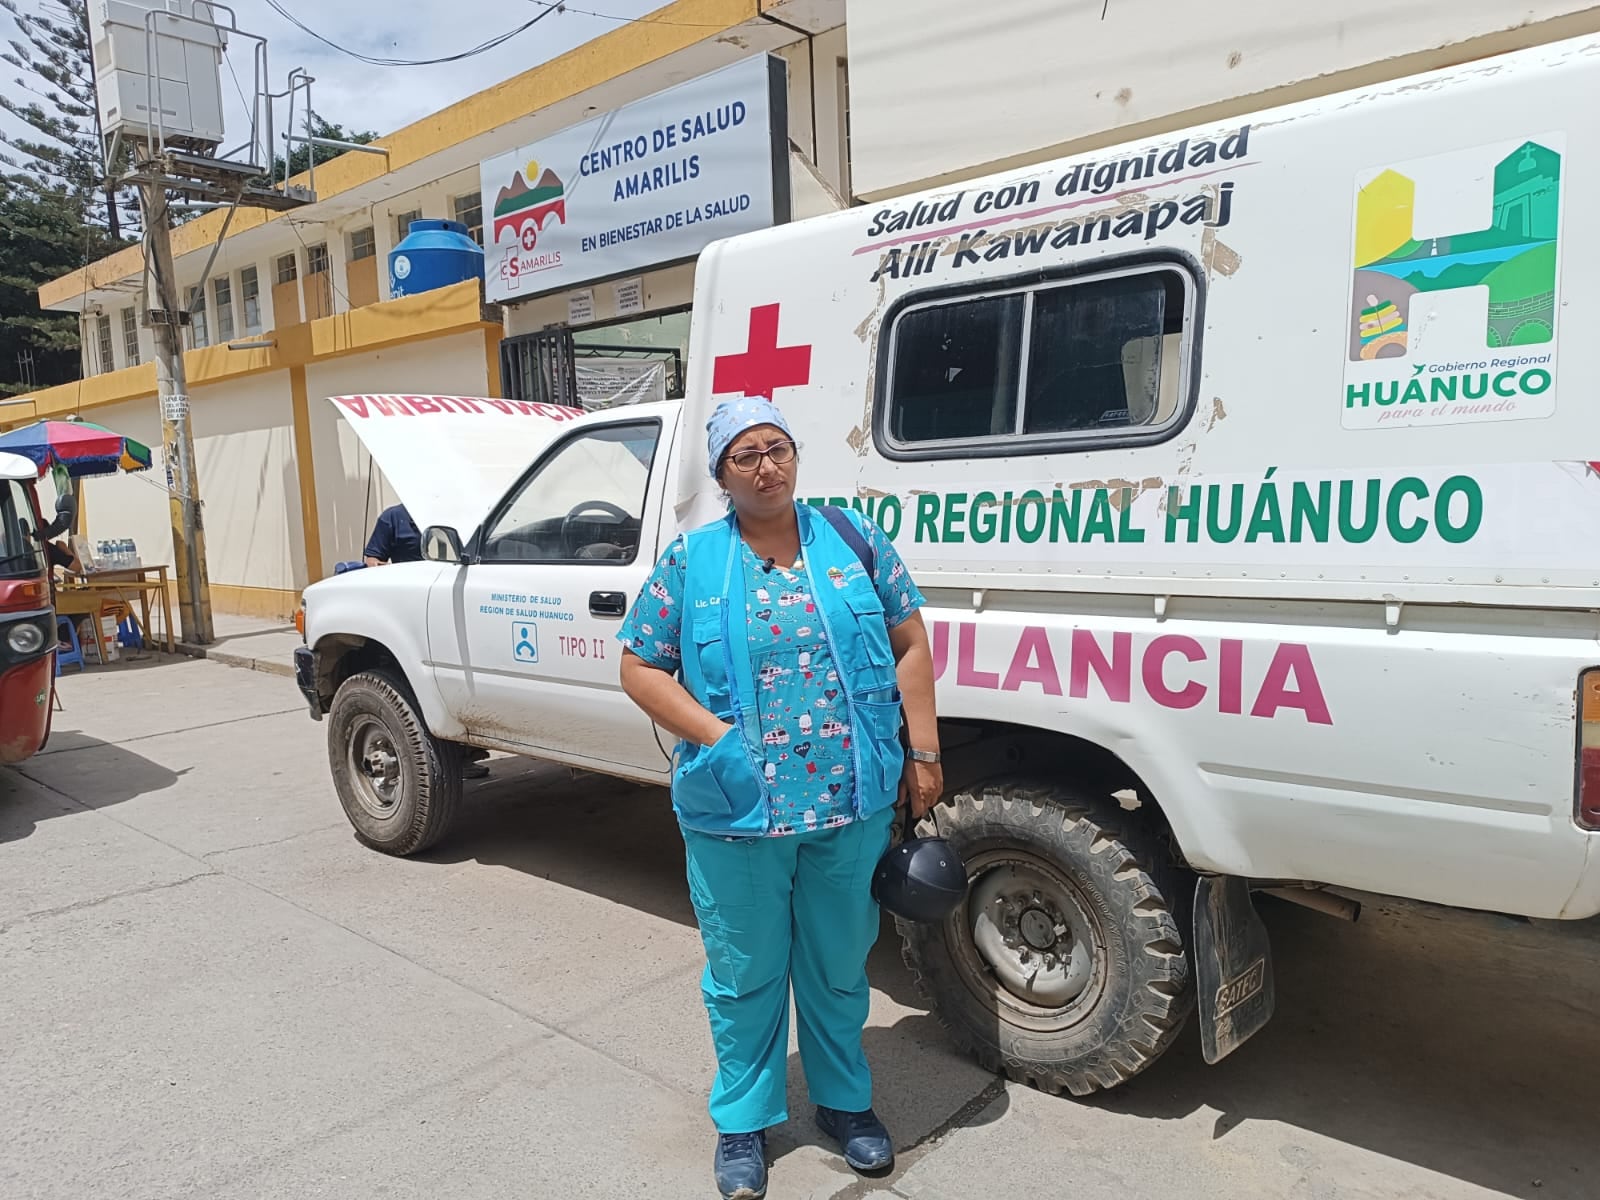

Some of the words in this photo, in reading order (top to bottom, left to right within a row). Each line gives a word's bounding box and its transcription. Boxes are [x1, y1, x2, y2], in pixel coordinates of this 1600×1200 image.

[580, 136, 647, 177] CENTRO
[652, 124, 677, 153] DE
[681, 101, 746, 143] SALUD
[613, 155, 700, 202] AMARILIS
[867, 191, 965, 237] Salud
[973, 180, 1041, 215] con
[1055, 124, 1252, 197] dignidad
[581, 236, 597, 252] EN
[600, 217, 663, 248] BIENESTAR
[665, 211, 683, 230] DE
[686, 206, 702, 225] LA
[705, 193, 750, 220] SALUD
[952, 182, 1234, 269] Kawanapaj
[520, 251, 561, 272] AMARILIS
[1428, 361, 1487, 373] Gobierno
[1490, 354, 1551, 369] Regional
[1346, 364, 1552, 408] HUÁNUCO
[1377, 406, 1424, 423] para
[1431, 403, 1448, 417] el
[1451, 399, 1517, 415] mundo
[914, 487, 1145, 544] REGIONAL
[1164, 466, 1484, 544] HUÁNUCO
[480, 605, 504, 615] REGION
[505, 607, 514, 616] DE
[516, 608, 538, 618] SALUD
[539, 611, 574, 622] HUANUCO
[491, 593, 526, 604] MINISTERIO
[530, 594, 539, 604] DE
[540, 595, 562, 606] SALUD
[559, 636, 586, 658] TIPO
[593, 638, 605, 659] II
